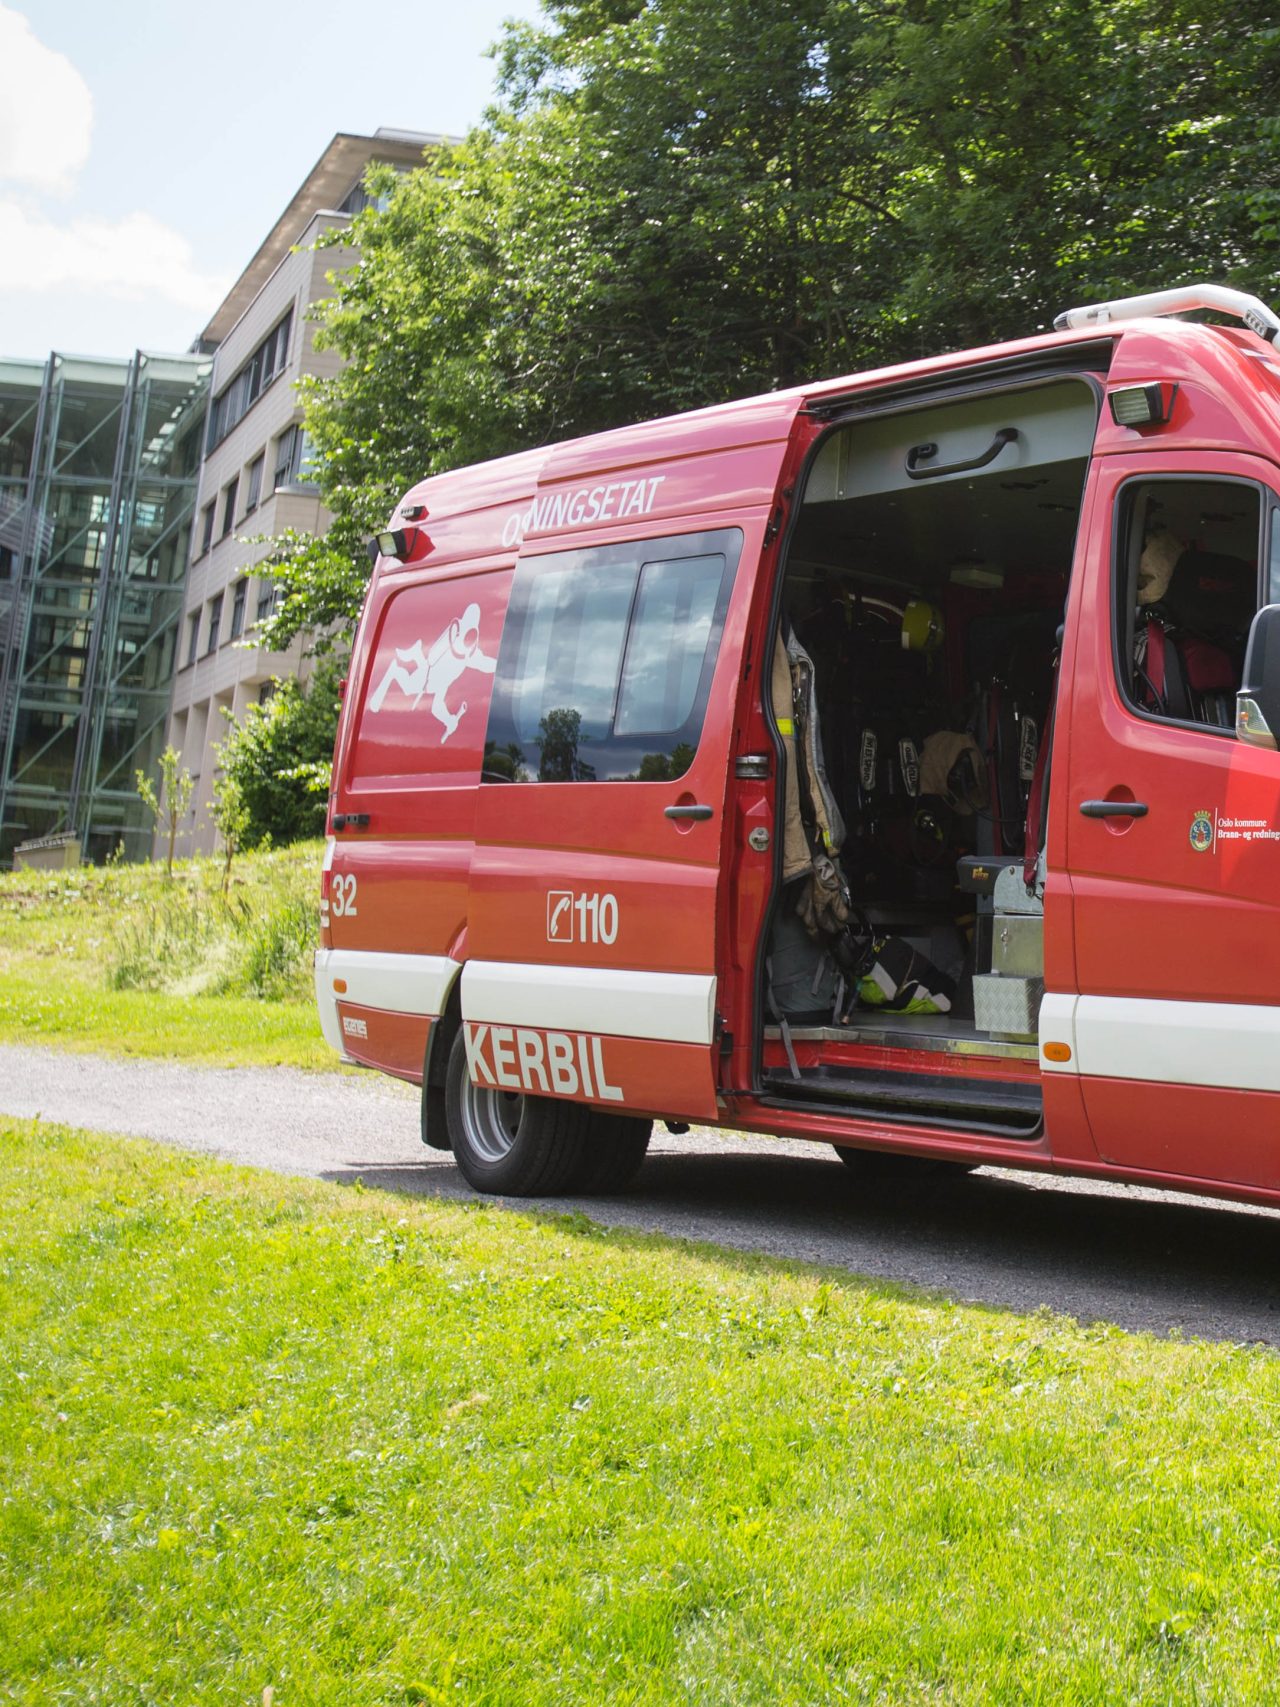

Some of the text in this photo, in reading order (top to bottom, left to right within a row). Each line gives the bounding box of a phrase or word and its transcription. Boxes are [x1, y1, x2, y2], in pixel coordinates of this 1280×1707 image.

[1217, 818, 1267, 828] Oslo kommune
[1217, 829, 1242, 839] Brann-
[1242, 831, 1252, 841] og
[332, 873, 358, 916] 32
[574, 892, 619, 945] 110
[463, 1023, 625, 1101] KERBIL
